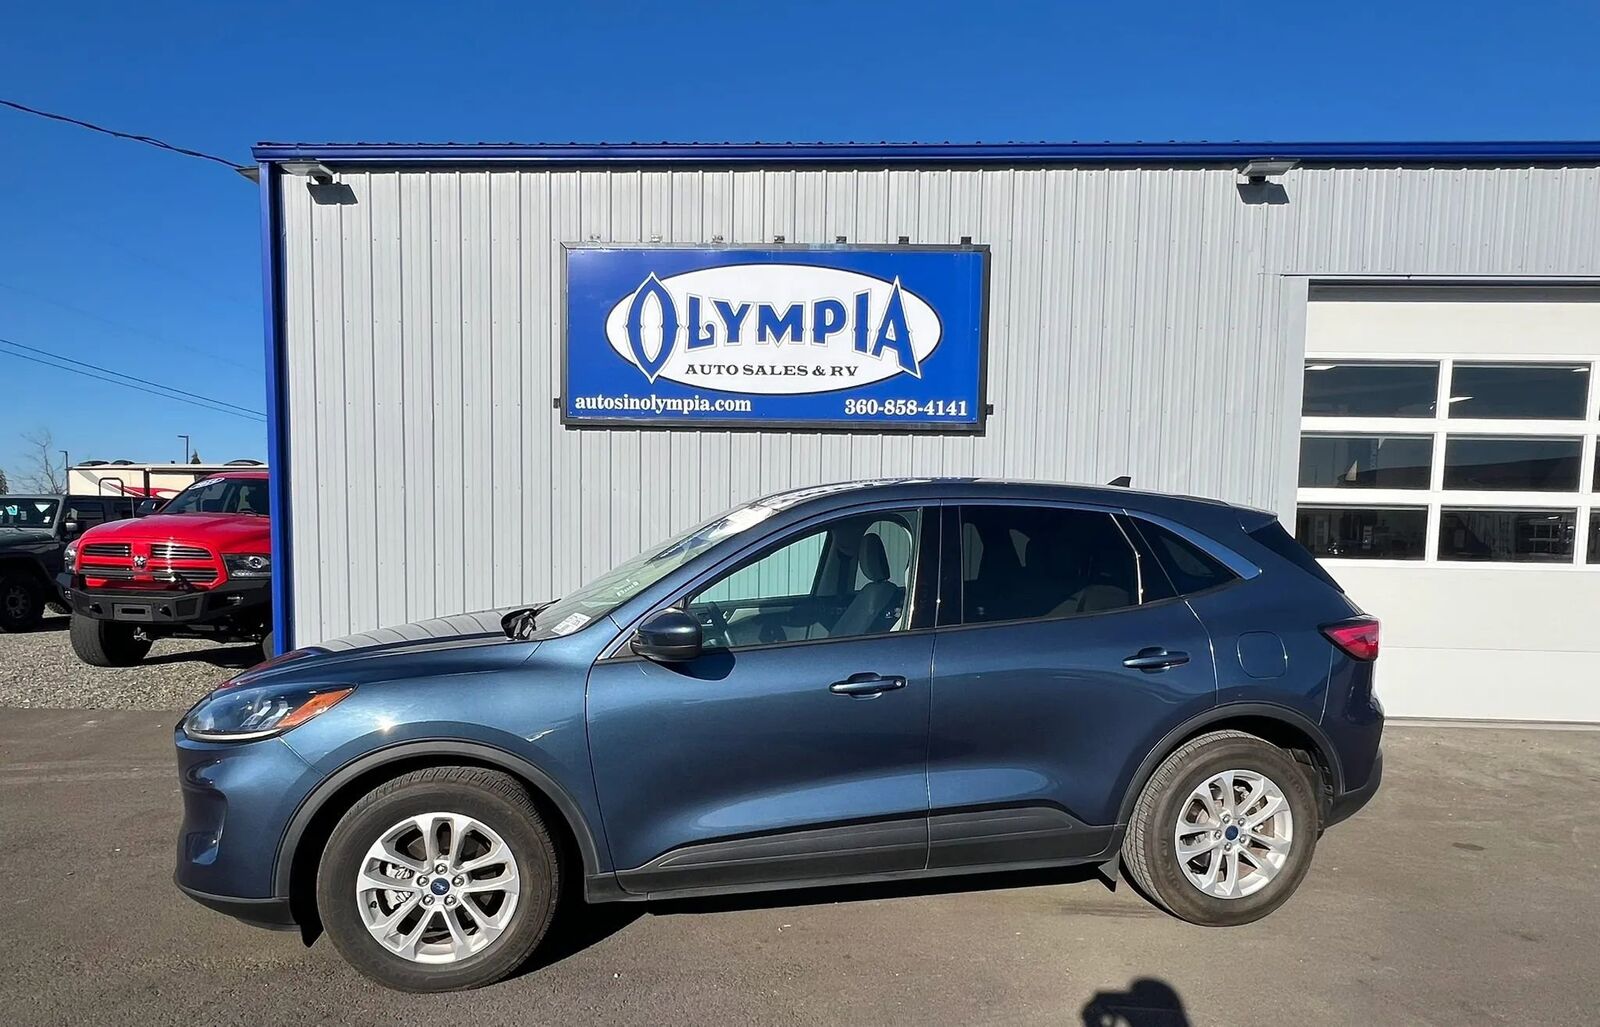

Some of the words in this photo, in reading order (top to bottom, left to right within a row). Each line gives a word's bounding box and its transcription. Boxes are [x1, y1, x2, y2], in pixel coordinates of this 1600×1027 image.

[625, 272, 921, 383] OLYMPIA
[685, 364, 739, 376] AUTO
[743, 365, 808, 376] SALES
[812, 366, 826, 376] &
[830, 366, 859, 377] RV
[575, 394, 752, 414] autosinolympia.com
[844, 399, 967, 416] 360-858-4141
